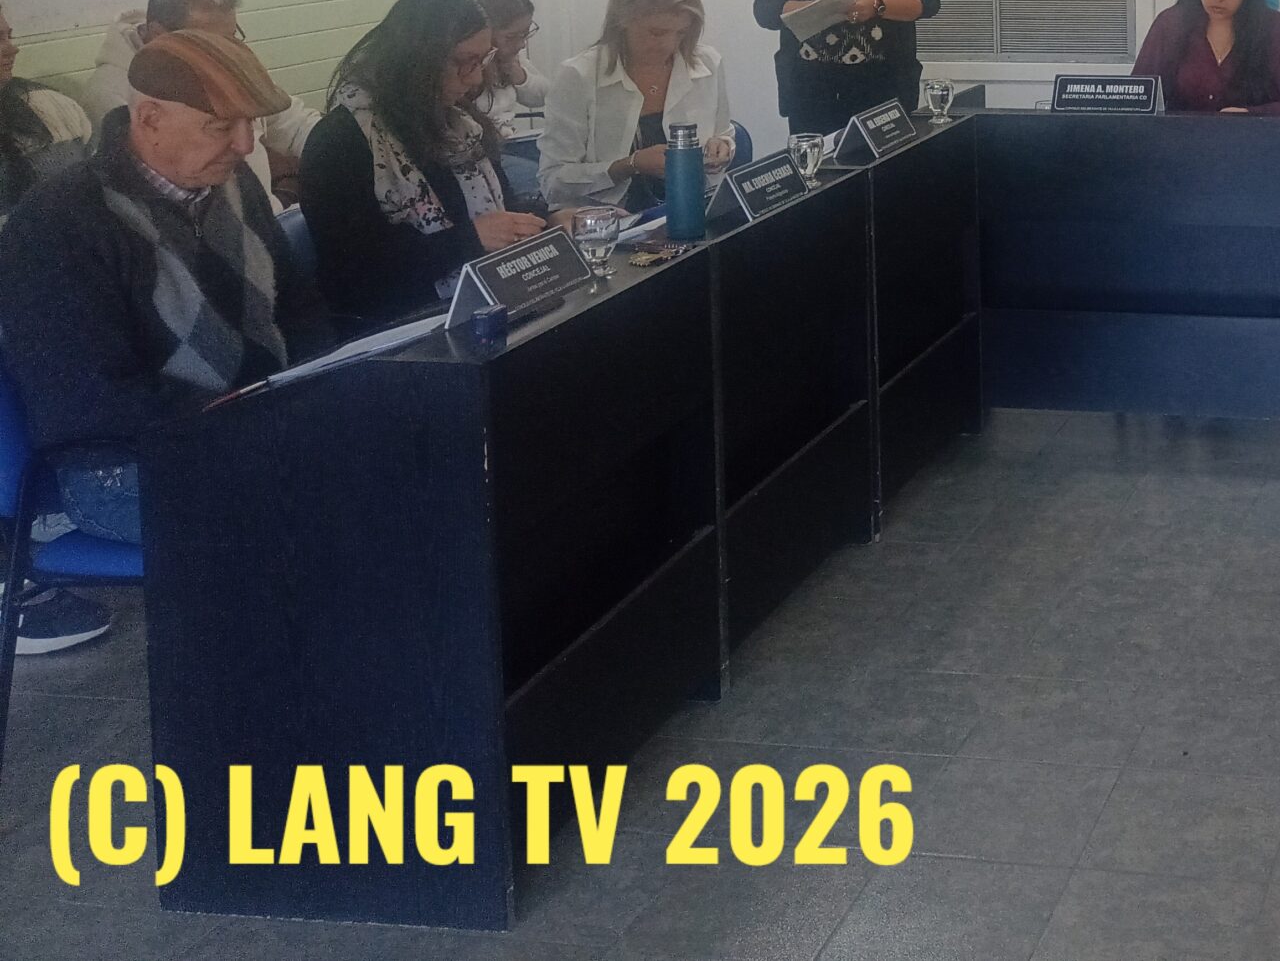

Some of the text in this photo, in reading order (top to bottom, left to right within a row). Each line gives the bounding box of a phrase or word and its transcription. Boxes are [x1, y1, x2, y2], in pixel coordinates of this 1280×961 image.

[1066, 84, 1095, 93] JIMENA
[1105, 85, 1145, 94] MONTERO
[496, 244, 560, 279] HÉCTOR VENICA
[521, 265, 551, 281] CONCEJAL
